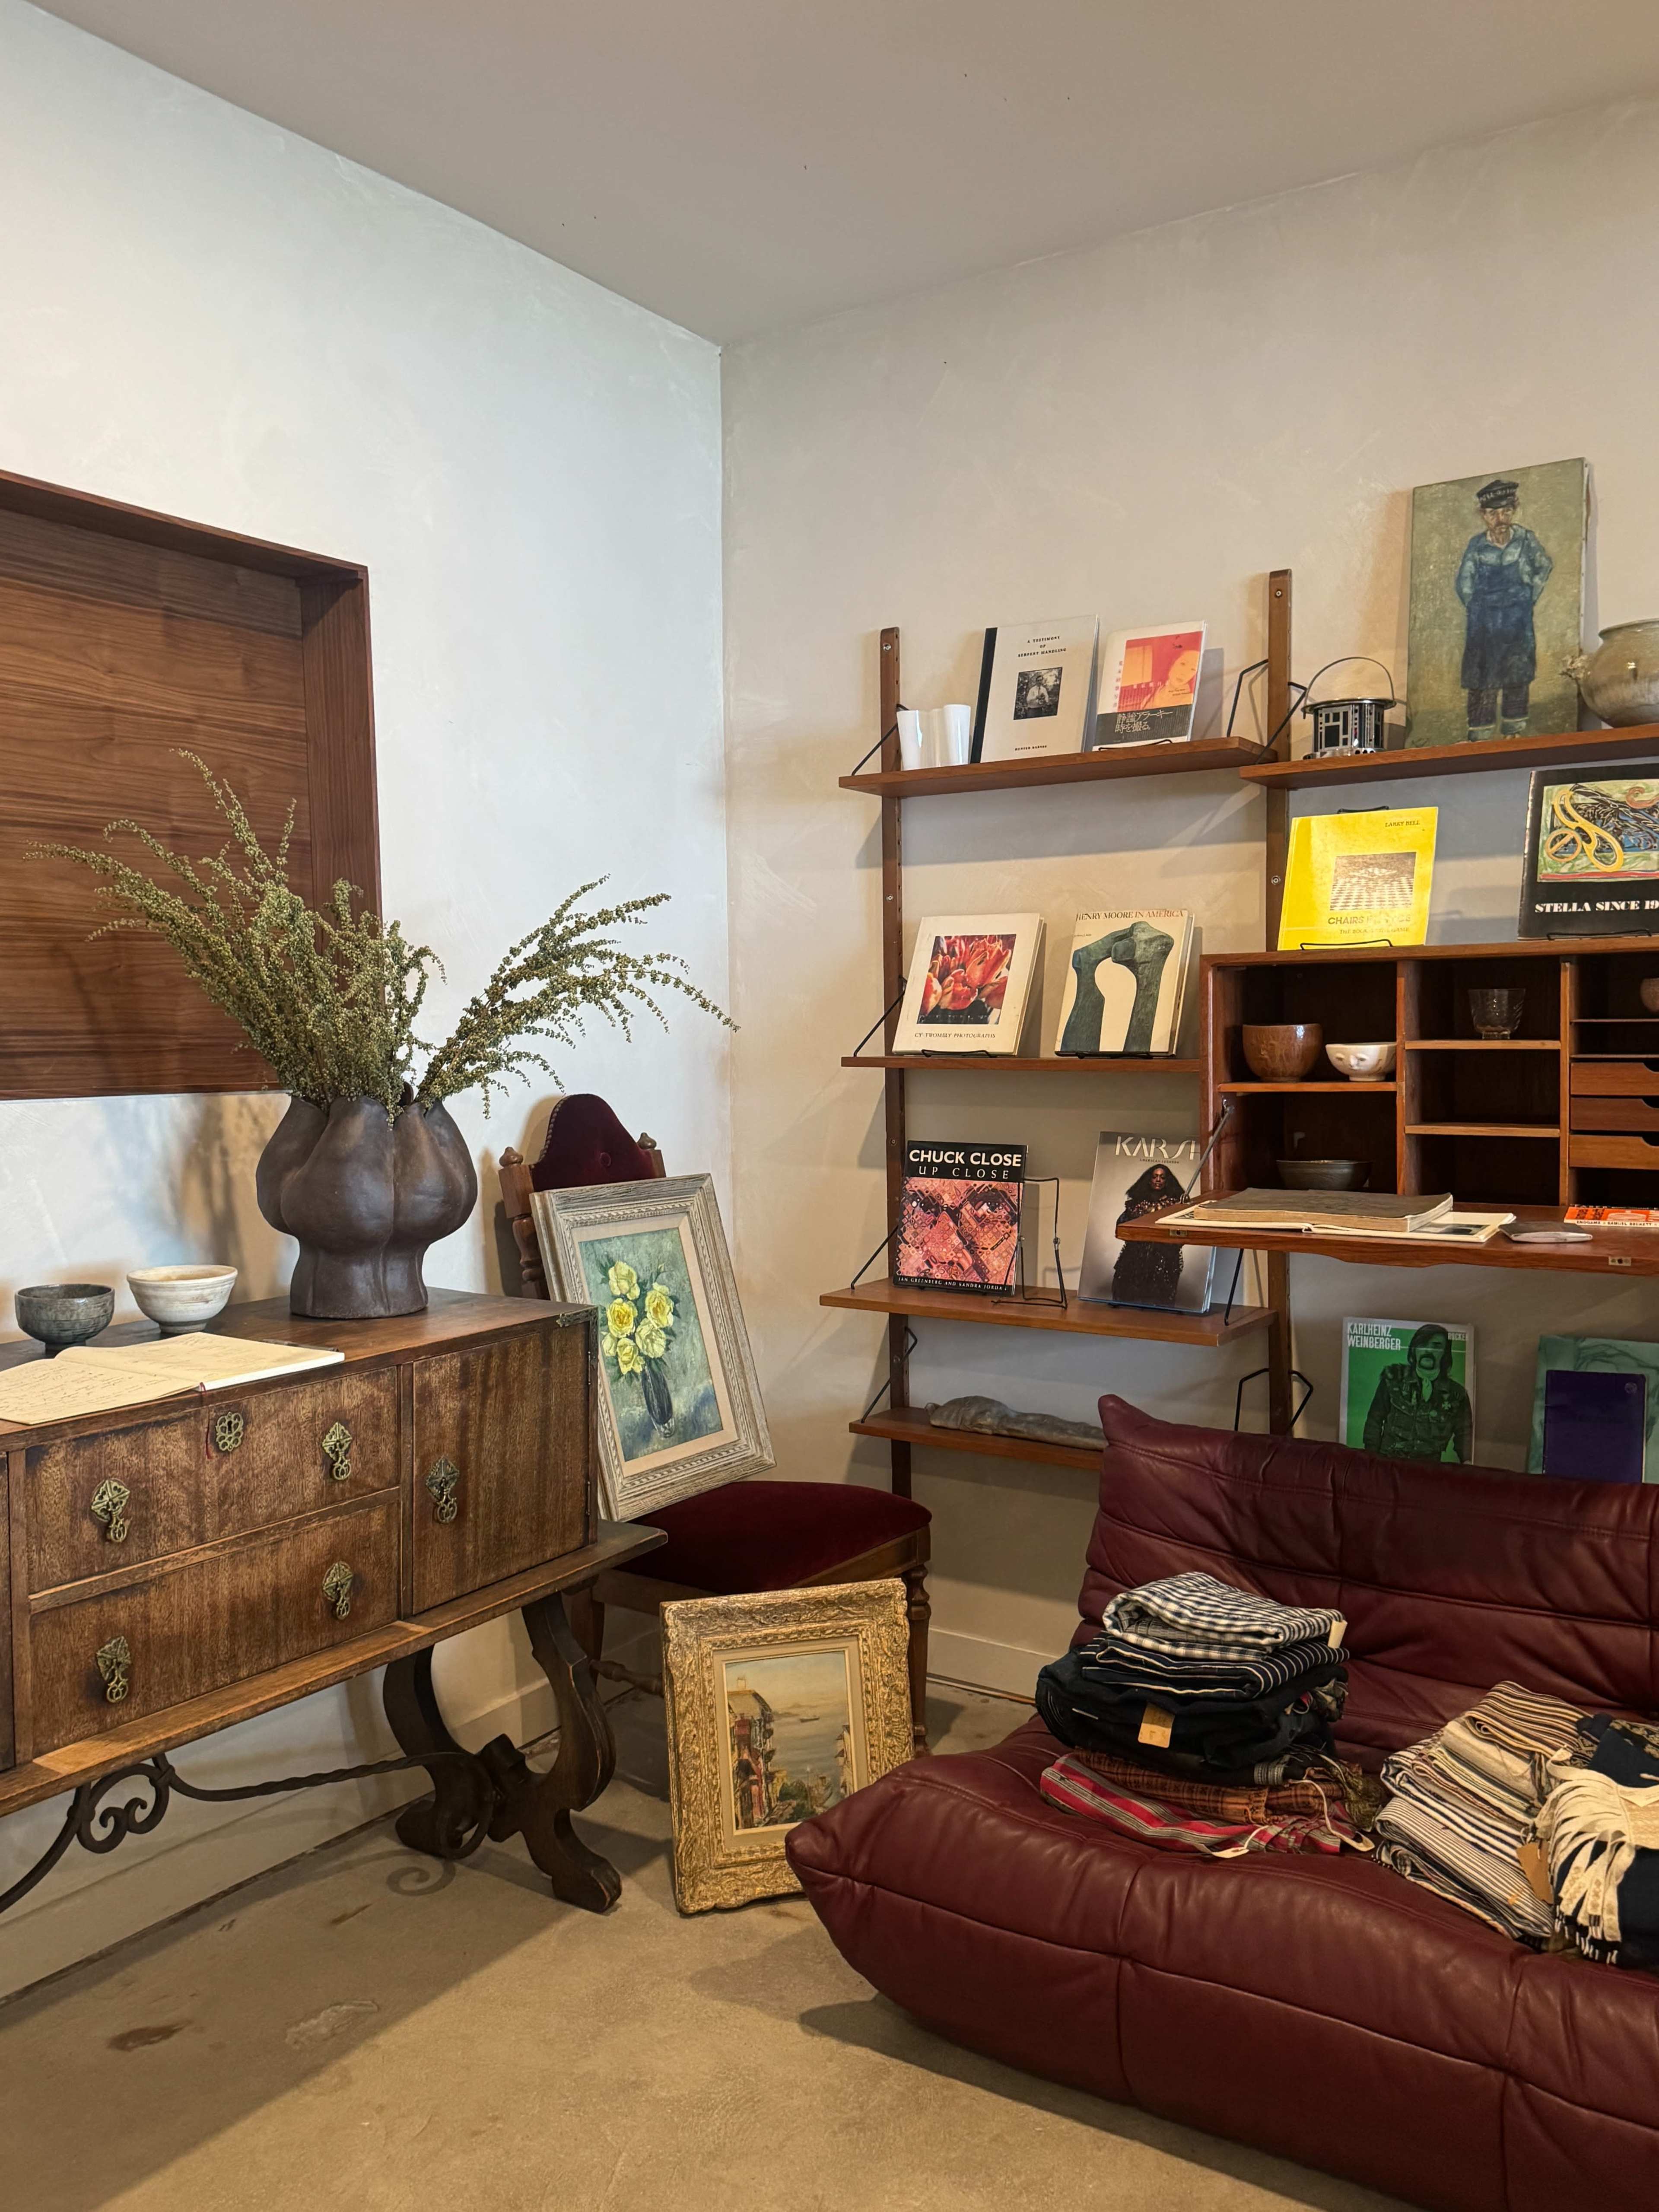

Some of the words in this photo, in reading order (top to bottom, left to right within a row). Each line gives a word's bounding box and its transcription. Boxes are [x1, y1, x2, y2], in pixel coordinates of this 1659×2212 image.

[1535, 902, 1591, 913] STELLA
[1595, 901, 1640, 911] SINCE
[1076, 913, 1101, 921] HENRY
[1103, 911, 1134, 920] MOORE
[1328, 916, 1364, 925] CHAIRS
[909, 1149, 965, 1164] CHUCK
[970, 1152, 1022, 1167] CLOSE
[918, 1166, 938, 1175] UP
[952, 1168, 1009, 1179] CLOSE
[1348, 1322, 1392, 1337] KARLHEINZ
[1348, 1334, 1401, 1351] WEINBERGER
